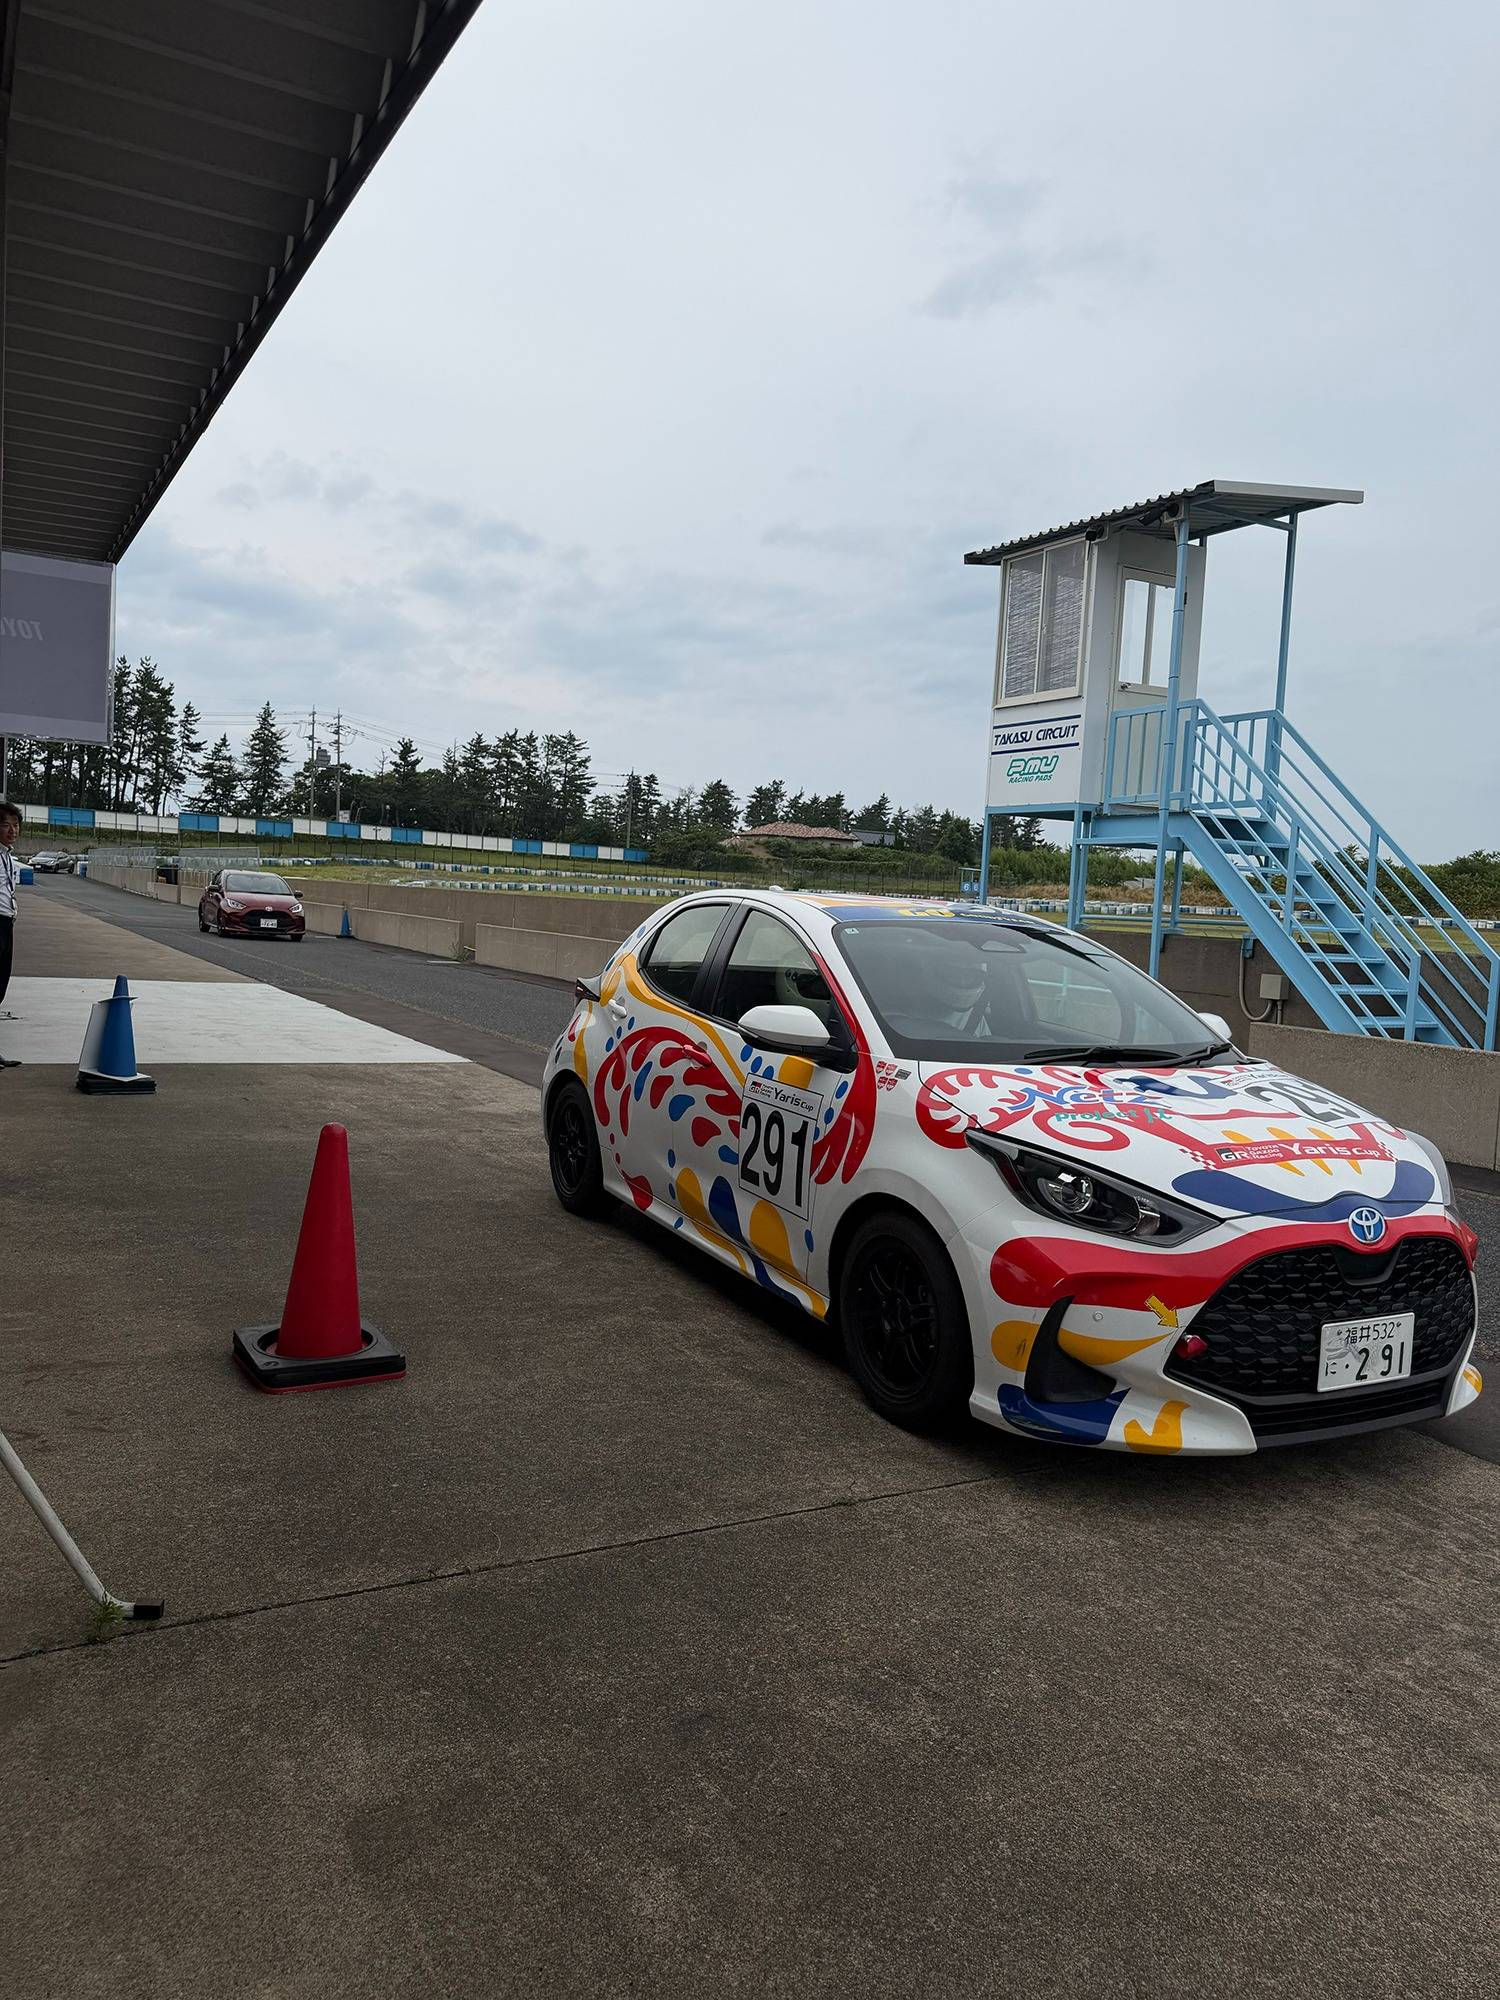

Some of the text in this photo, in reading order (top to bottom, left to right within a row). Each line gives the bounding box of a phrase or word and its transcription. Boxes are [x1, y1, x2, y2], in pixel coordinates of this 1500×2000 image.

[994, 724, 1079, 746] TAKASU CIRCUIT
[1008, 774, 1053, 784] RACING PADS
[774, 1087, 801, 1106] Yaris
[801, 1101, 814, 1112] Cup
[740, 1102, 809, 1208] 291
[1220, 1151, 1251, 1161] GR
[1278, 1143, 1381, 1157] Yaris Cup
